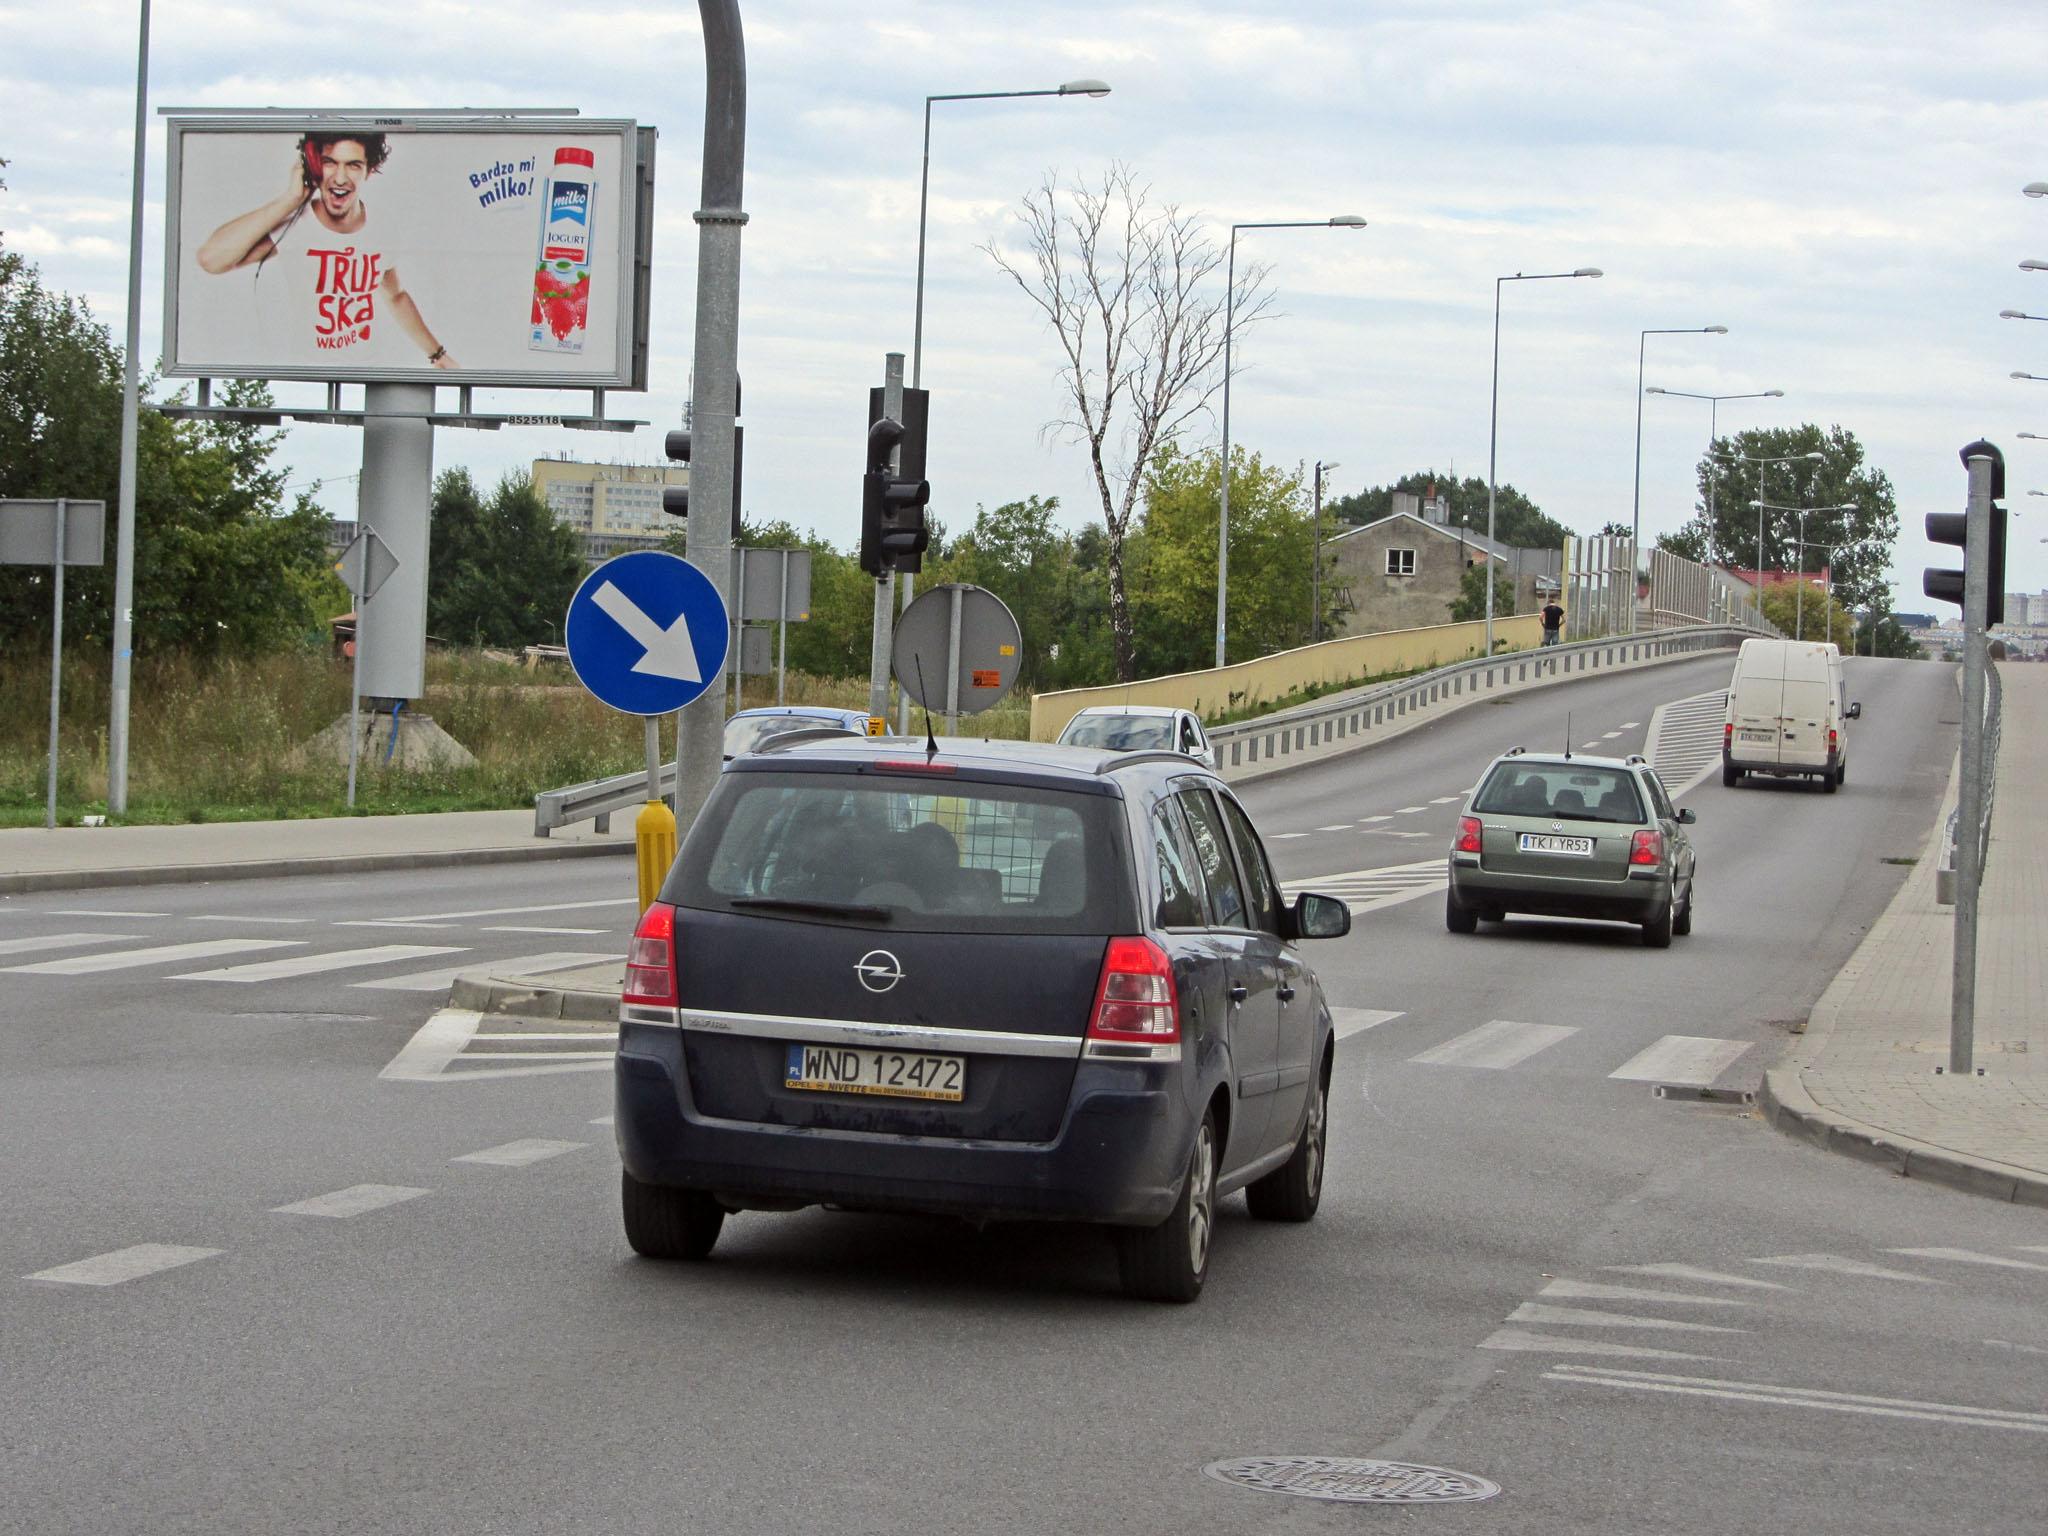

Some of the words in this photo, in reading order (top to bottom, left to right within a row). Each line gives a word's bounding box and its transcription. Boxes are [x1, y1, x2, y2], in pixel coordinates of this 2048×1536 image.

[469, 161, 514, 188] Bardzo
[519, 156, 535, 172] mi
[479, 177, 534, 208] milko!
[553, 190, 586, 207] milko
[307, 246, 381, 296] TRUE
[509, 415, 559, 424] 8525118
[1560, 838, 1589, 851] YR53
[790, 1066, 801, 1075] PL
[805, 1048, 860, 1082] WND
[873, 1054, 961, 1090] 12472
[787, 1080, 810, 1089] OPEL
[828, 1082, 867, 1093] NIVETTE
